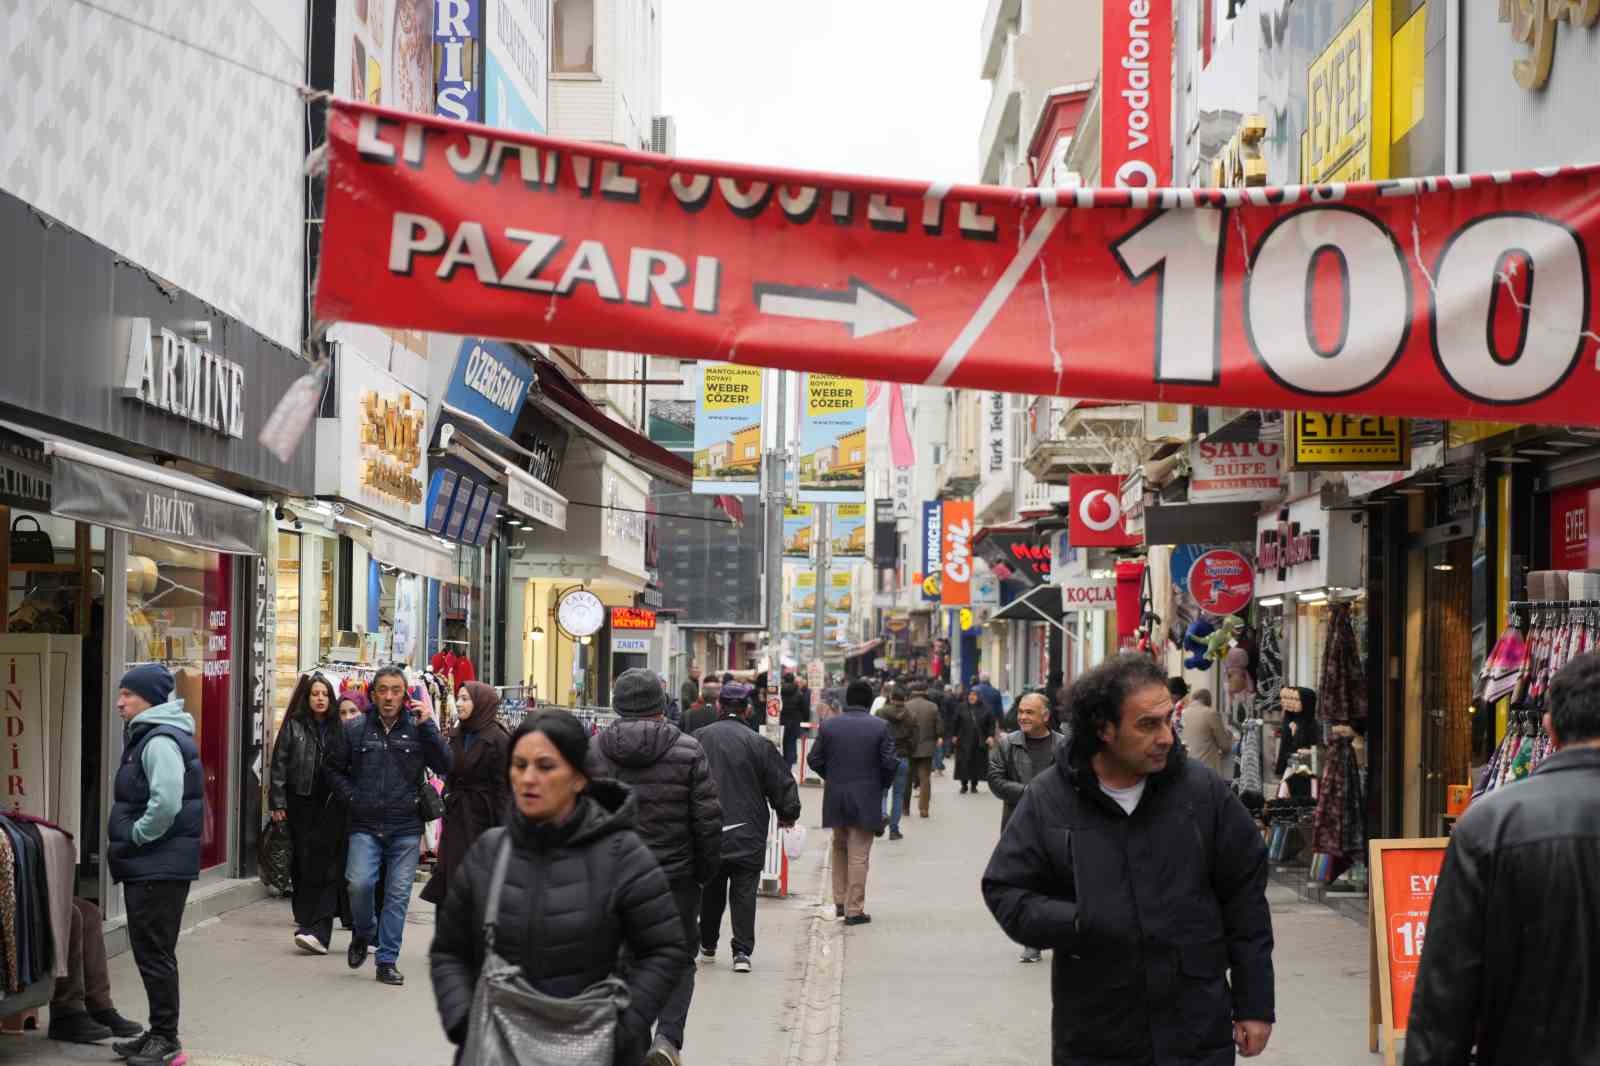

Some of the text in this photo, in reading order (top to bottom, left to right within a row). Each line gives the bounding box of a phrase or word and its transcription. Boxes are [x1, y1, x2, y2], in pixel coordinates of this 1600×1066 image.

[1121, 0, 1150, 150] vodafone
[388, 211, 722, 315] PAZARI
[706, 383, 749, 393] WEBER
[810, 388, 853, 398] WEBER
[142, 489, 195, 537] ARMİNE
